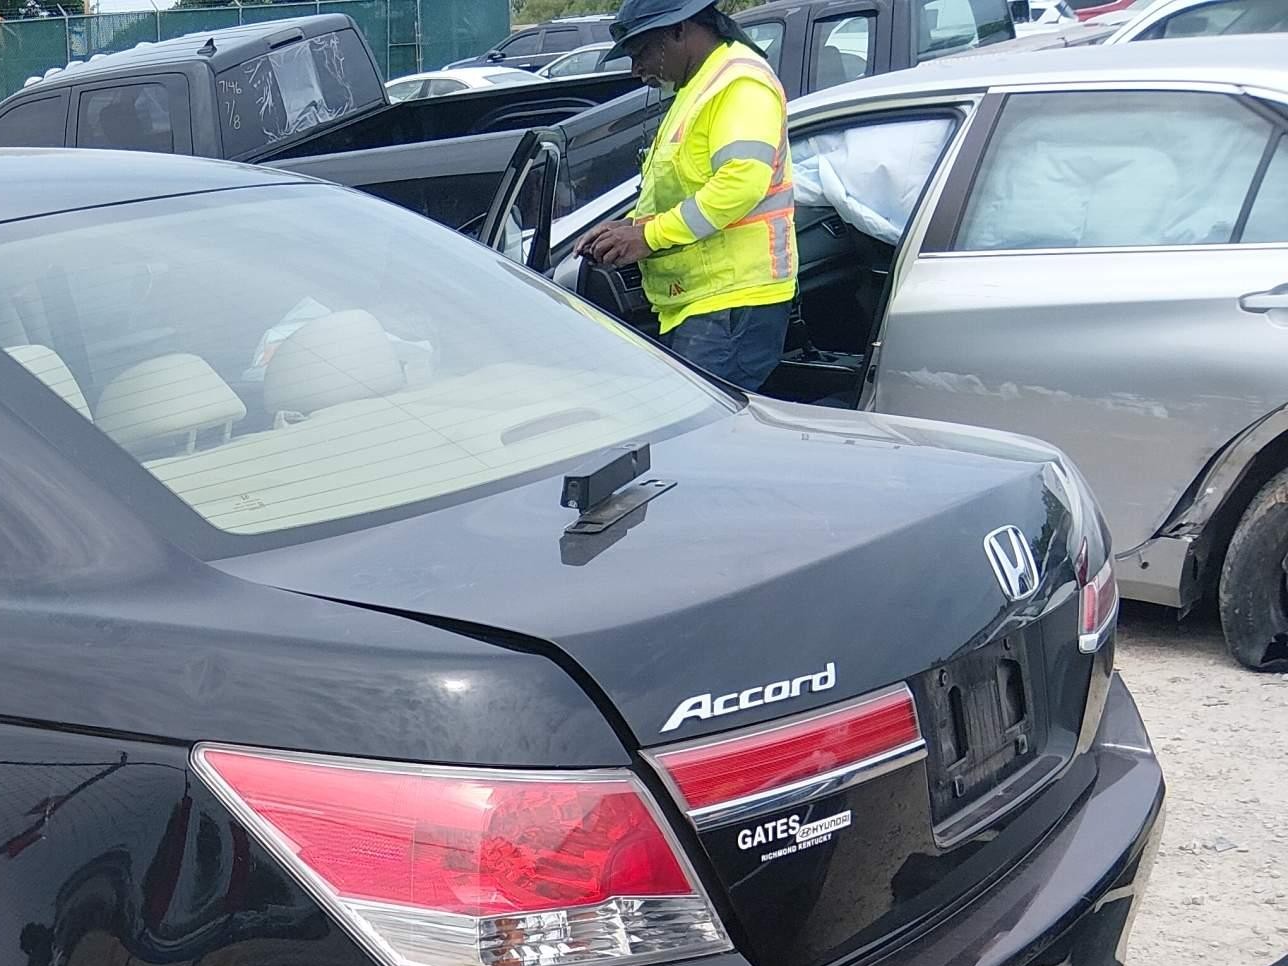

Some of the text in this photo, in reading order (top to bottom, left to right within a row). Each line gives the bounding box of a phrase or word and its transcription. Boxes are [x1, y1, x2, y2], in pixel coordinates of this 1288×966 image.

[659, 662, 836, 733] Accord
[737, 815, 800, 849] GATES
[812, 813, 850, 834] HYUNDAI
[761, 833, 832, 862] RICHMOND KENTUCKY
